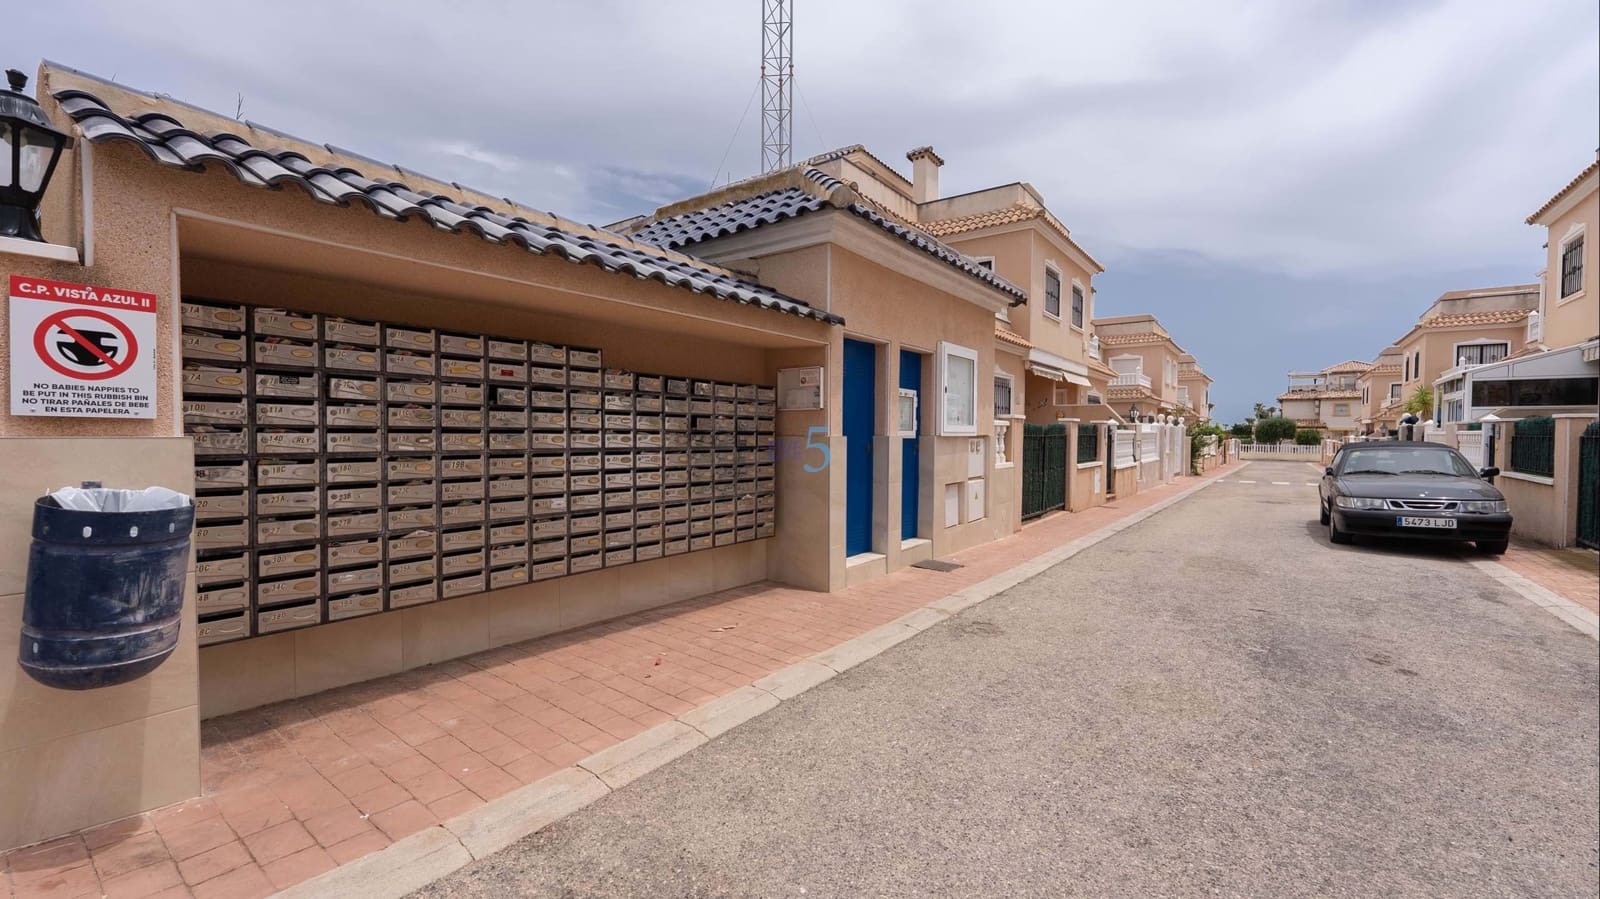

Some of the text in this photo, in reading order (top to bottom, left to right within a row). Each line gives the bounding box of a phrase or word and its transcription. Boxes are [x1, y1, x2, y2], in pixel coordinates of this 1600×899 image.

[18, 282, 150, 308] C.P. VISTA AZUL II
[52, 384, 85, 392] BABIES
[88, 386, 126, 394] NAPPIES
[72, 392, 93, 400] THIS
[94, 393, 132, 401] RUBBISH
[40, 398, 69, 406] TIRAR
[71, 398, 113, 408] PAÑALES
[60, 406, 83, 414] ESTA
[85, 407, 130, 415] PAPELERA
[1404, 517, 1431, 527] 5473
